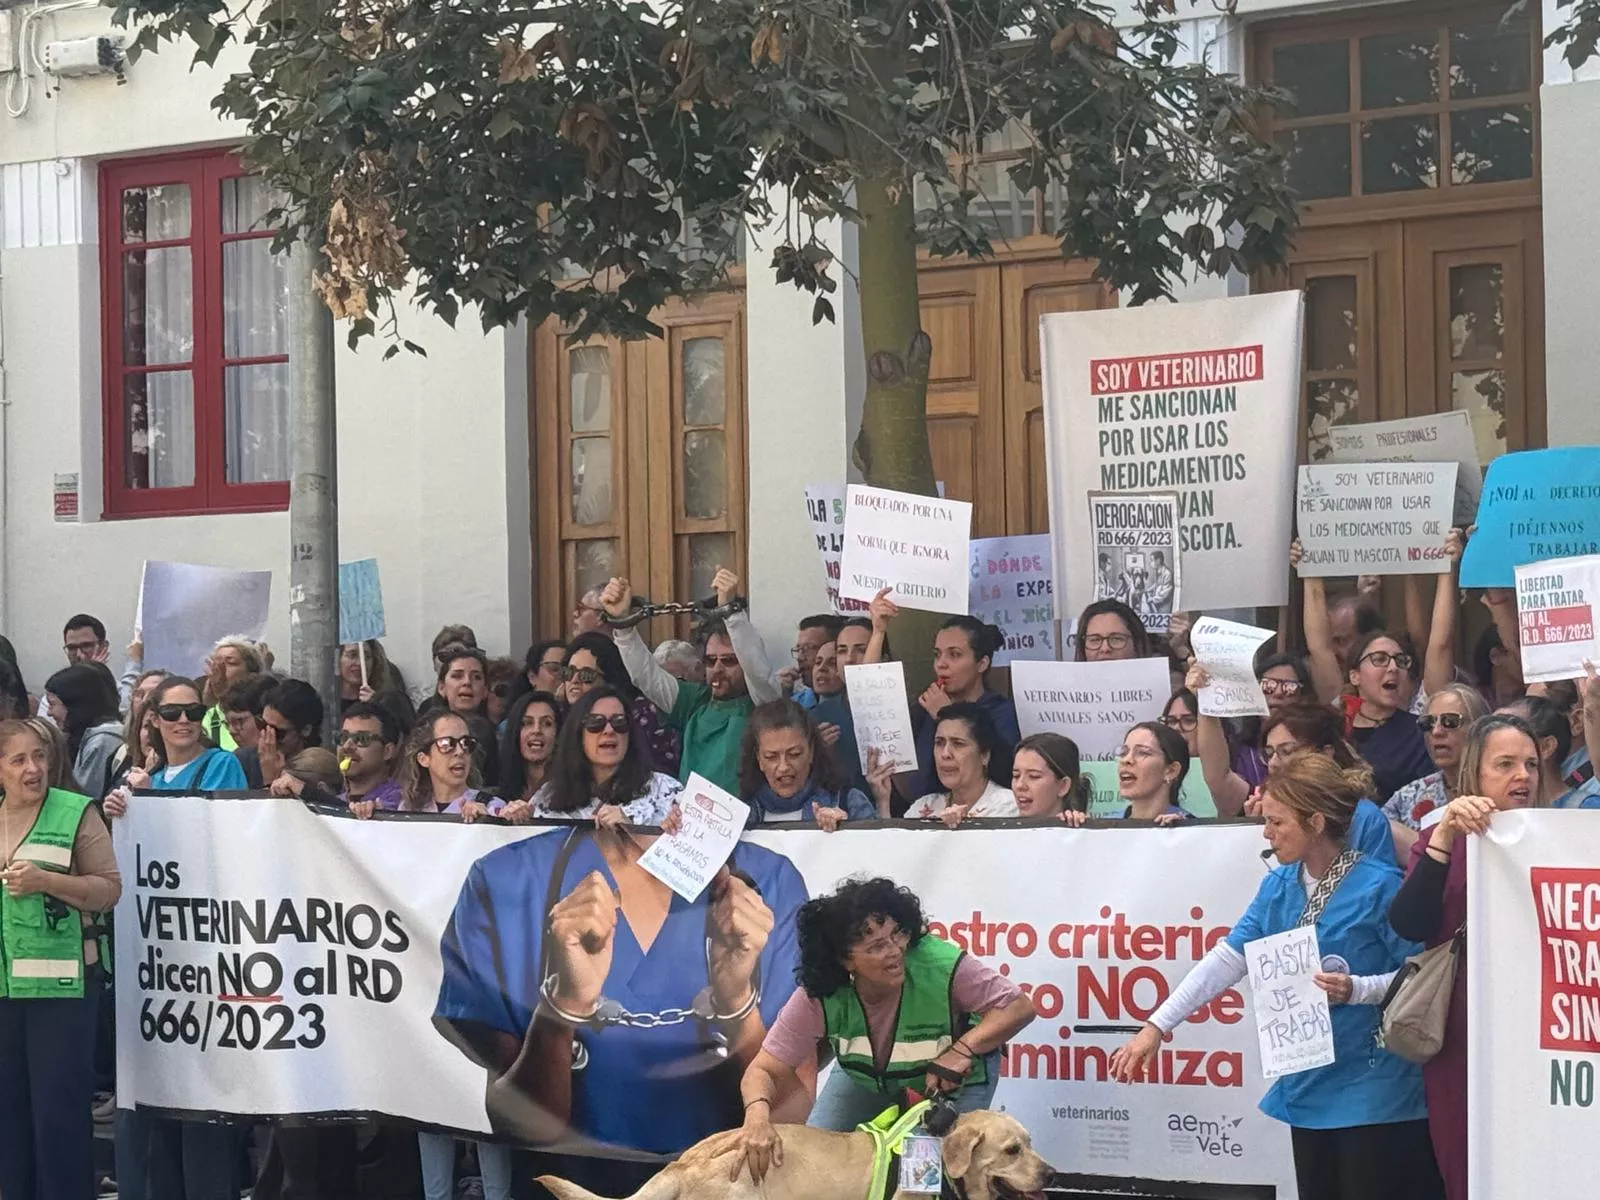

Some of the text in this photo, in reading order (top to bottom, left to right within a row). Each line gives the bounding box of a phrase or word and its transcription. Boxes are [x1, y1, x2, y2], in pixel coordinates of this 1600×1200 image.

[1097, 350, 1257, 391] SOY VETERINARIO
[1098, 386, 1237, 423] ME SANCIONAN
[1099, 420, 1229, 457] POR USAR LOS
[1376, 427, 1437, 448] PROFESIONALES
[1101, 453, 1246, 491] MEDICAMENTOS
[1335, 471, 1434, 486] SOY VETERINARIO
[1300, 495, 1431, 512] ME SANCIONAN POR USAR
[1523, 487, 1536, 501] AL
[855, 494, 953, 522] BLOQUEADOS POR UNA
[1095, 503, 1173, 530] DEROGACION
[1099, 531, 1172, 546] RD 666/2023
[1309, 520, 1441, 538] LOS MEDICAMENTOS QUE
[857, 534, 950, 561] NORMA QUE IGNORA
[1302, 547, 1445, 564] SALVAN TU MASCOTA NO 666
[1529, 542, 1598, 556] TRABAJAR
[896, 582, 947, 600] CRITERIO
[1520, 574, 1564, 594] LIBERTAD
[1520, 594, 1546, 611] PARA
[1522, 611, 1551, 629] NO AL
[1523, 623, 1592, 645] R.D. 666/2023
[1024, 688, 1153, 704] VETERINARIOS LIBRES
[1038, 710, 1135, 724] ANIMALES SANOS
[136, 843, 180, 890] Los
[1541, 882, 1600, 931] NEC
[136, 894, 410, 953] VETERINARIOS
[1258, 936, 1319, 981] BASTA
[138, 945, 403, 1003] dicen NO al RD
[1077, 965, 1169, 1021] NO
[1270, 986, 1301, 1012] DE
[140, 998, 326, 1052] 666/2023
[1260, 1002, 1331, 1049] TRABAS
[1551, 992, 1600, 1043] SIN
[1551, 1059, 1594, 1107] NO
[1052, 1105, 1130, 1121] veterinarios
[1168, 1113, 1219, 1135] aem
